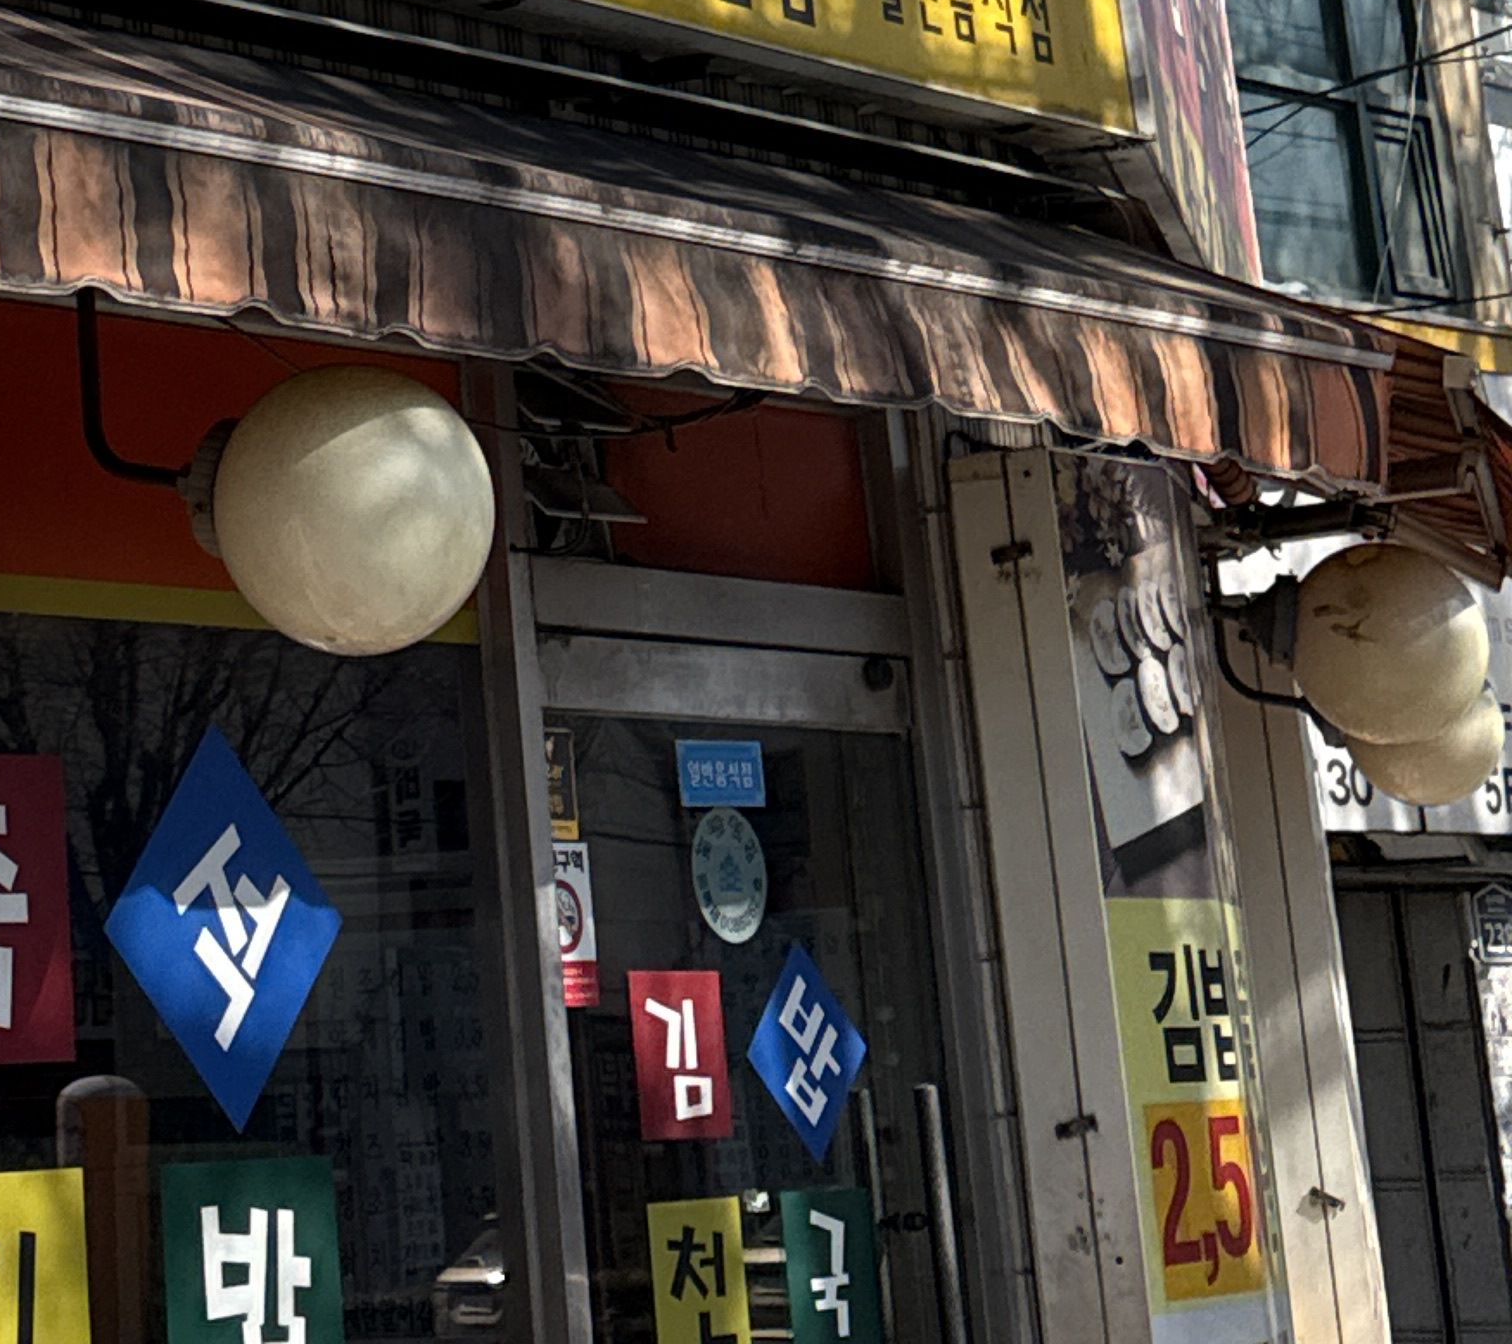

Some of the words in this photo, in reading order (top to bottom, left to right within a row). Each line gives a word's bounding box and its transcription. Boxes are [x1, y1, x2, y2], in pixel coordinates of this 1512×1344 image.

[643, 997, 714, 1122] 김
[778, 974, 842, 1128] 밥
[666, 1225, 739, 1344] 천
[808, 1209, 851, 1339] 국
